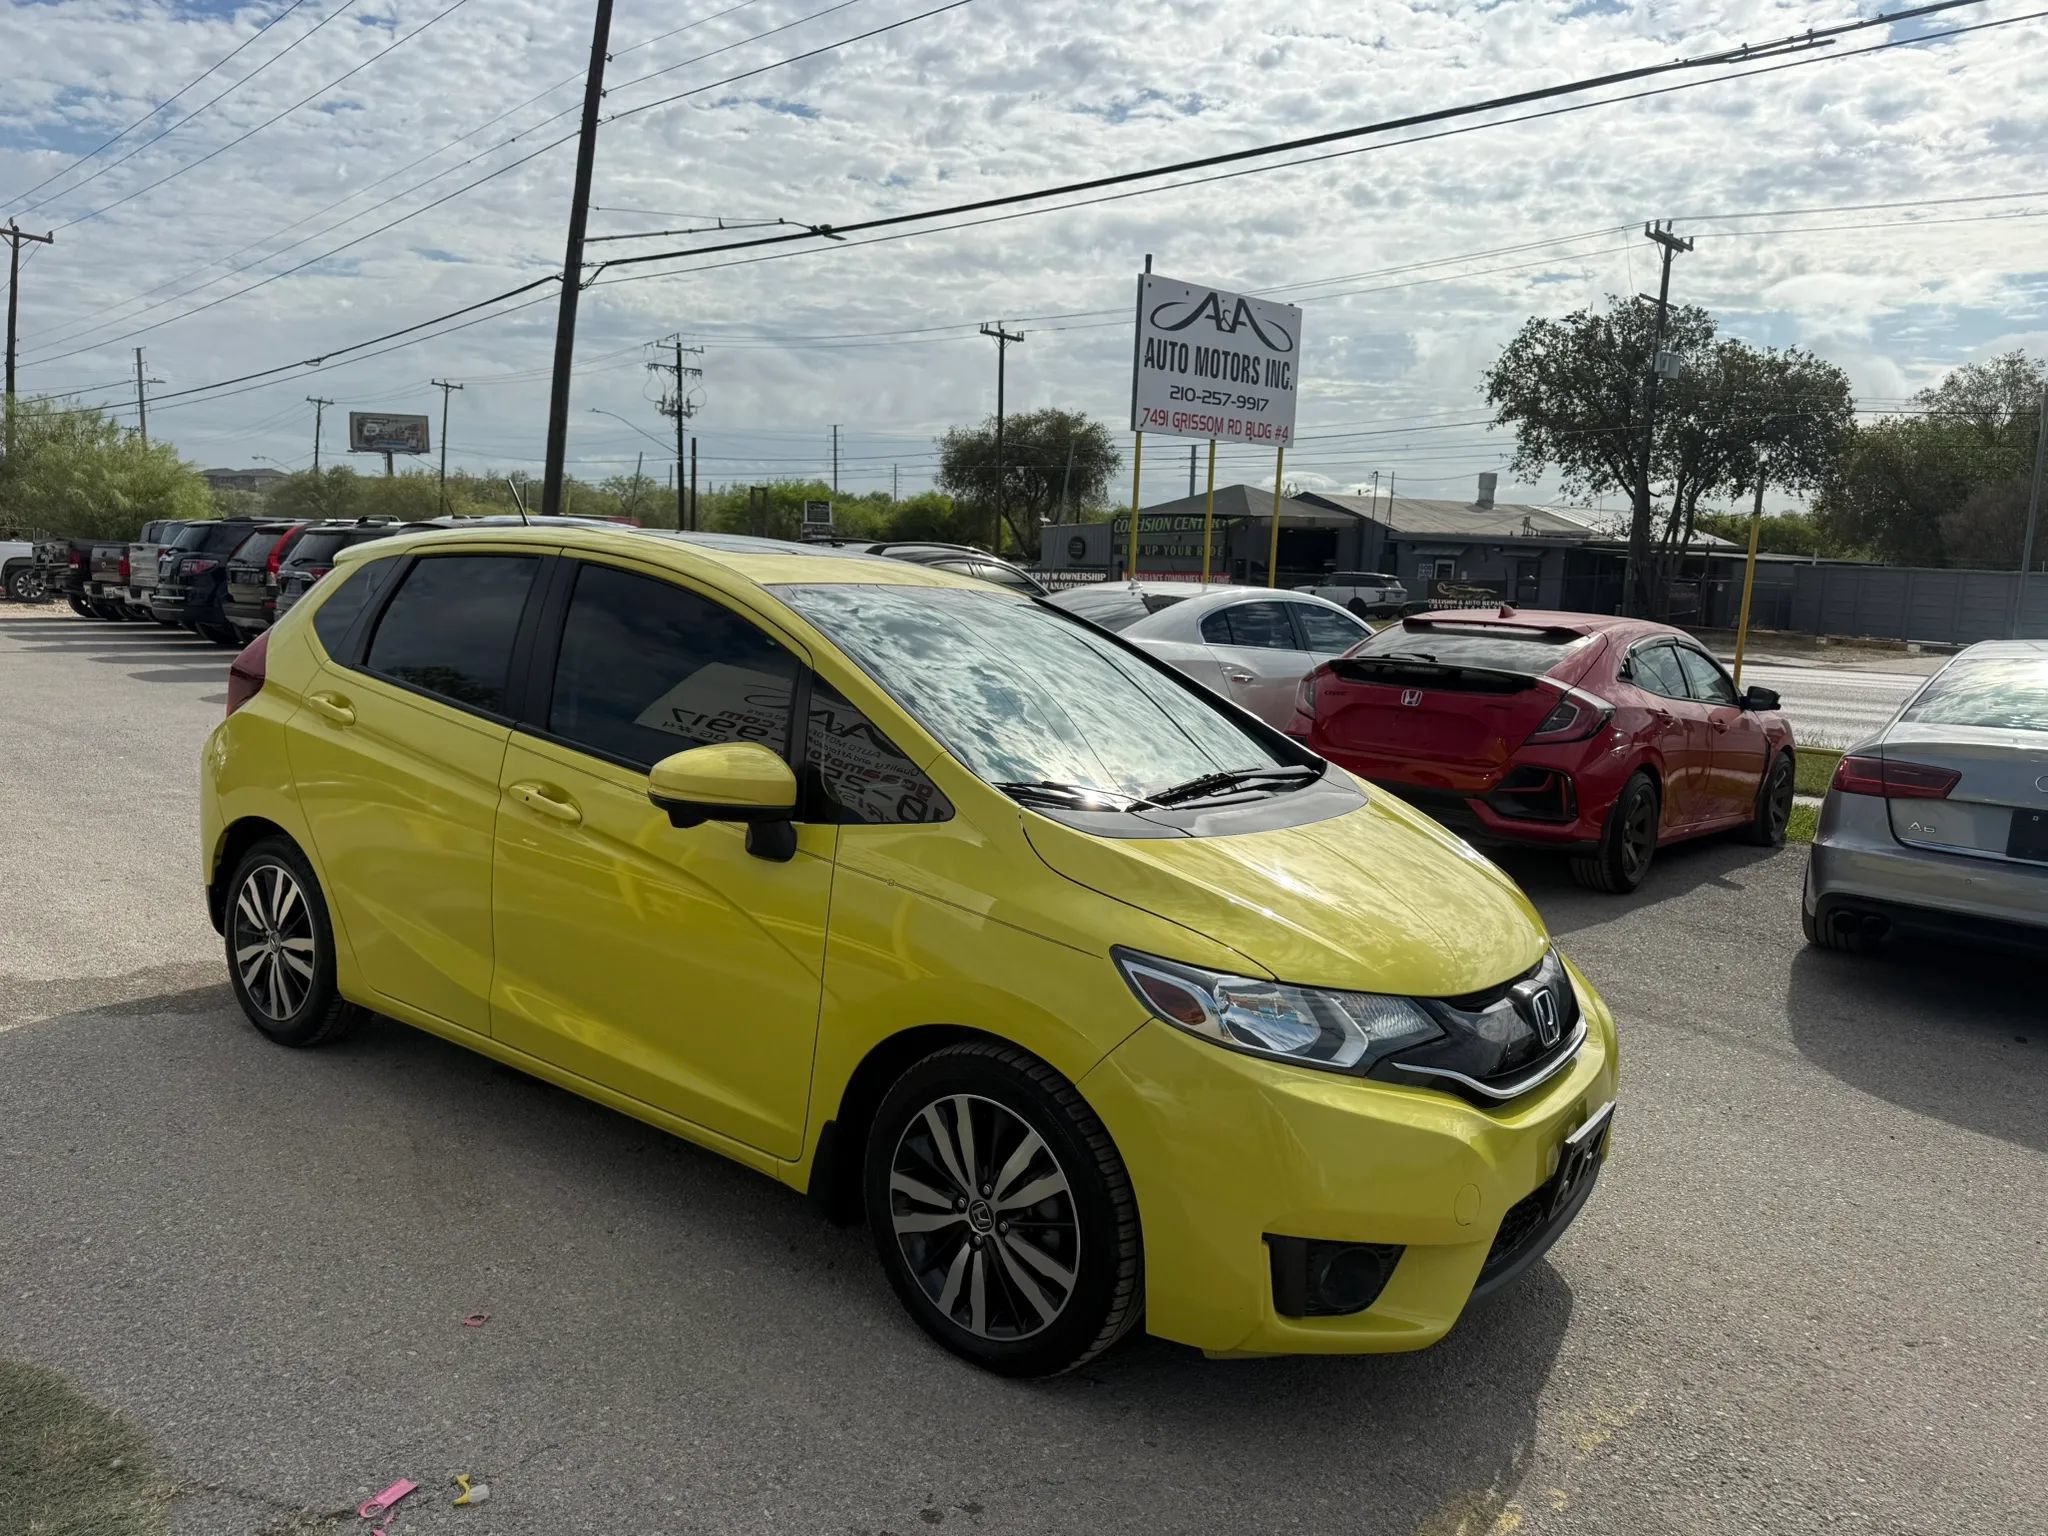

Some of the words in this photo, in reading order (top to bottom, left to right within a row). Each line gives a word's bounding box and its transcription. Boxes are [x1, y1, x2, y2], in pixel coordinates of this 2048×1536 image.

[1144, 337, 1189, 374] AUTO
[1194, 346, 1260, 385] MOTORS
[1264, 358, 1293, 391] INC.
[1169, 385, 1269, 412] 210-257-9917
[1142, 408, 1168, 427] 7491
[1172, 411, 1224, 434] GRISSOM
[1228, 418, 1242, 435] RD
[1246, 422, 1271, 439] BLDG
[1275, 425, 1289, 441] #4
[1145, 545, 1159, 556] UP
[1163, 545, 1192, 556] YOUR
[1060, 572, 1106, 581] OWNERSHIP
